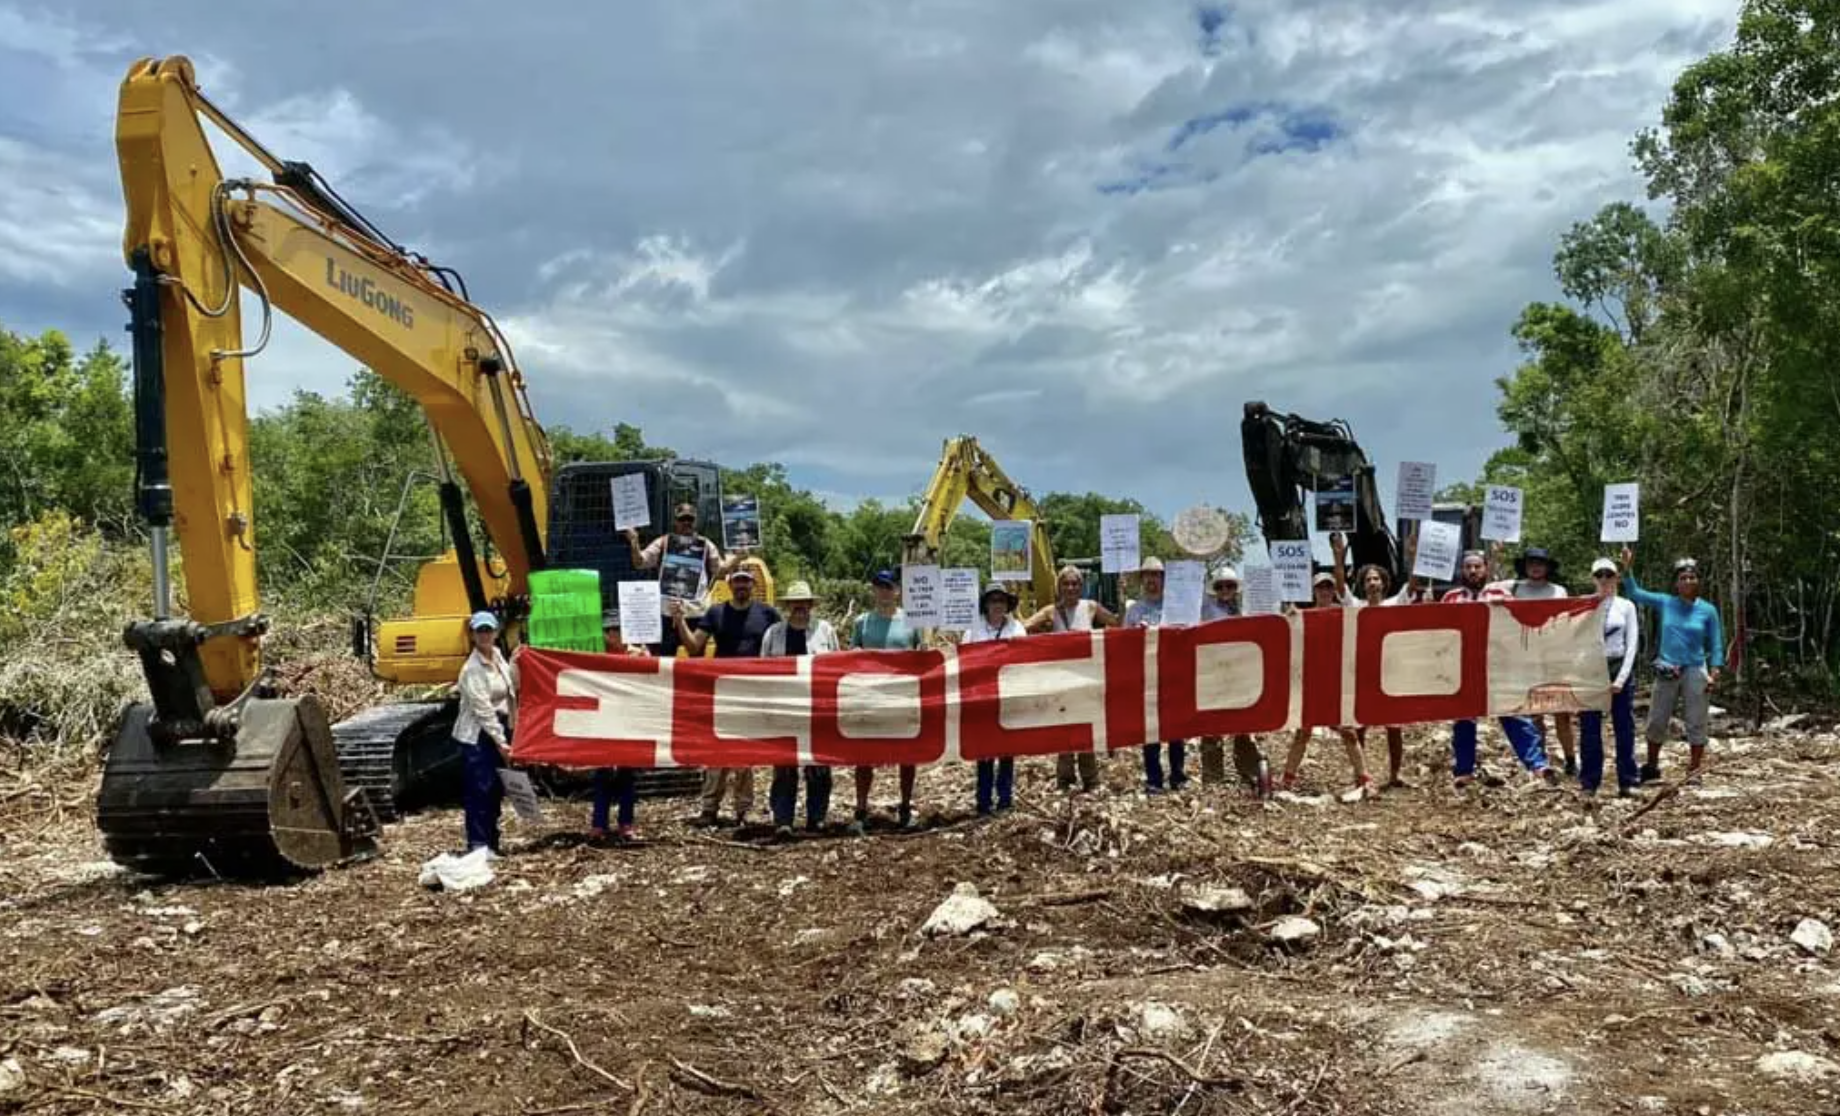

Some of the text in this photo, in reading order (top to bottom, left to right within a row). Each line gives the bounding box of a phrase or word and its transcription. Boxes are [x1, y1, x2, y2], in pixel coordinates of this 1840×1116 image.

[1491, 490, 1517, 503] SOS
[1614, 519, 1629, 528] NO
[1278, 545, 1305, 558] SOS
[913, 575, 928, 584] NO
[511, 601, 1490, 770] ECOCIDIO
